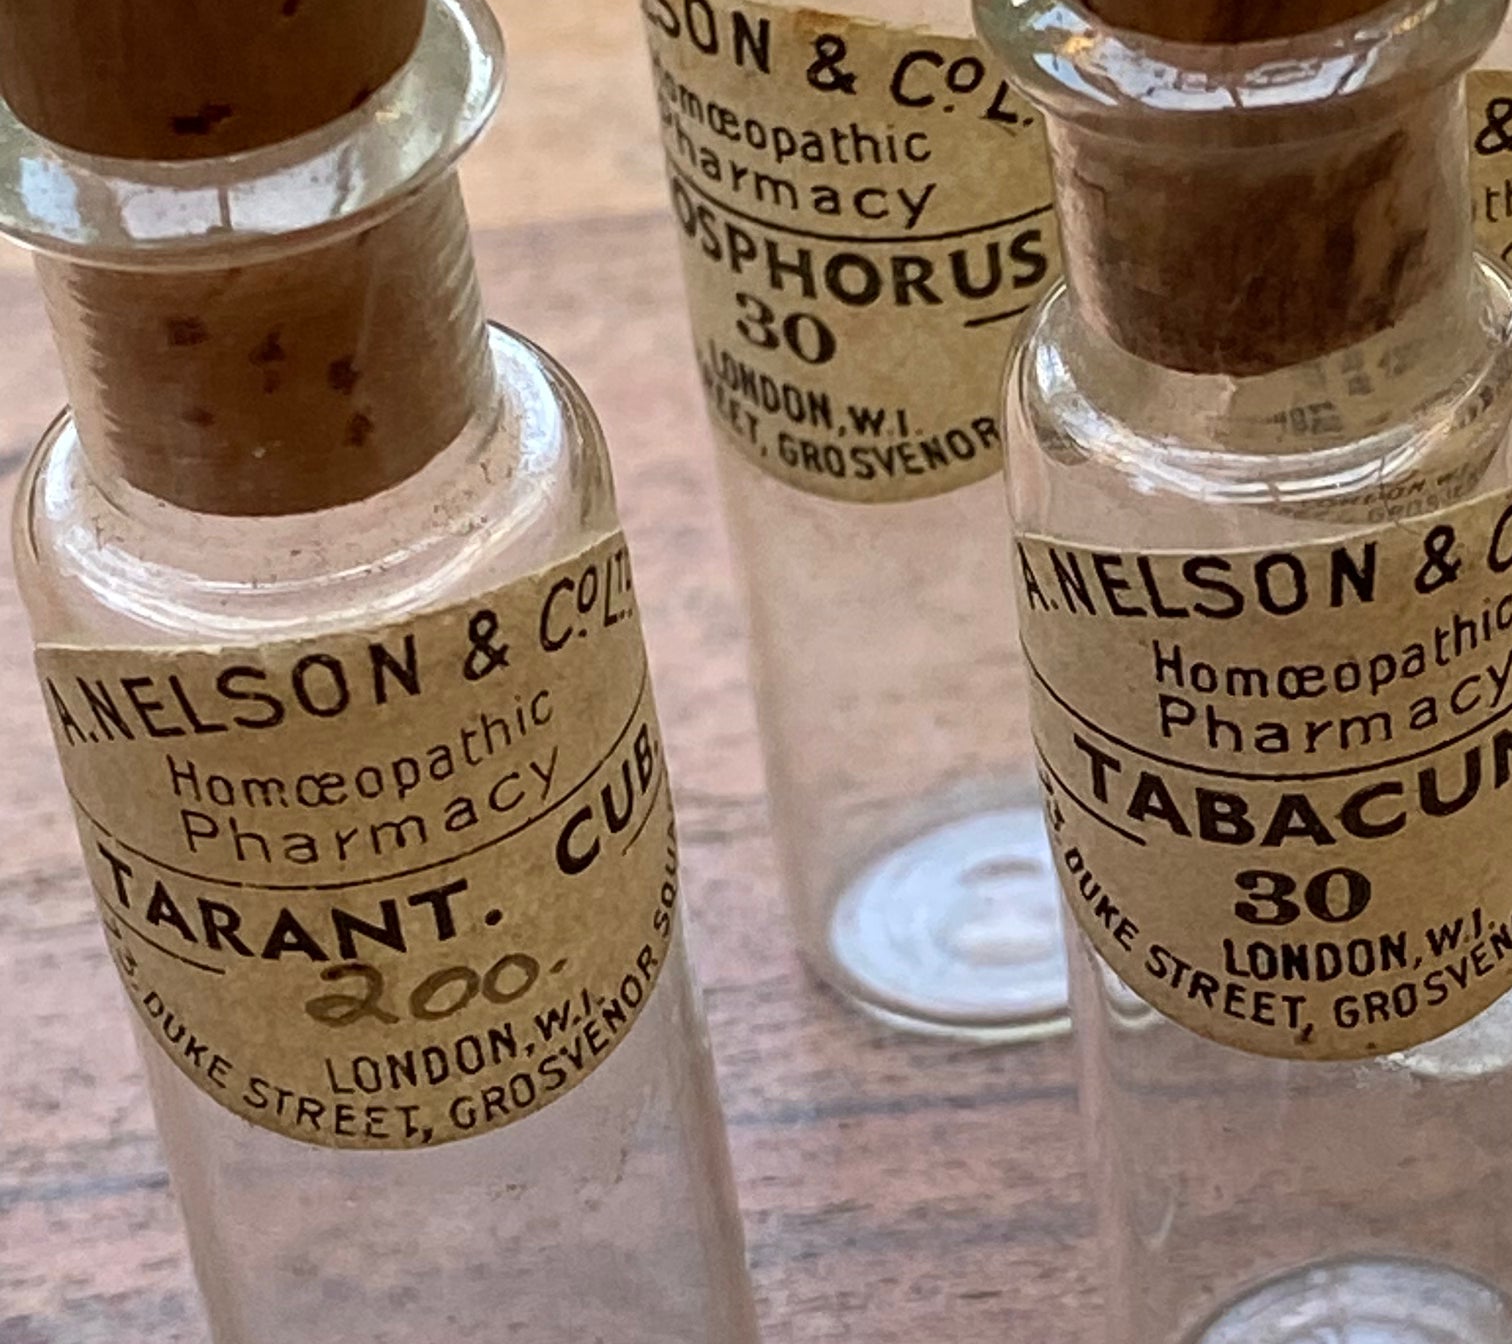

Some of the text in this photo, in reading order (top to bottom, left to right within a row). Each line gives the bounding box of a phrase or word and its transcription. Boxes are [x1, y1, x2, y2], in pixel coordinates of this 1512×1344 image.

[807, 34, 856, 94] &
[672, 176, 1047, 306] OSPHORUS
[736, 293, 836, 364] 30
[778, 417, 1000, 479] GROSVENOR
[1414, 524, 1462, 594] &
[462, 609, 511, 682] &
[181, 746, 559, 865] Pharmacy
[98, 841, 504, 964] TARANT.
[1064, 847, 1140, 953] DUKE
[1234, 866, 1372, 926] 30
[143, 991, 233, 1089] DUKE
[450, 944, 658, 1129] GROSVENOR
